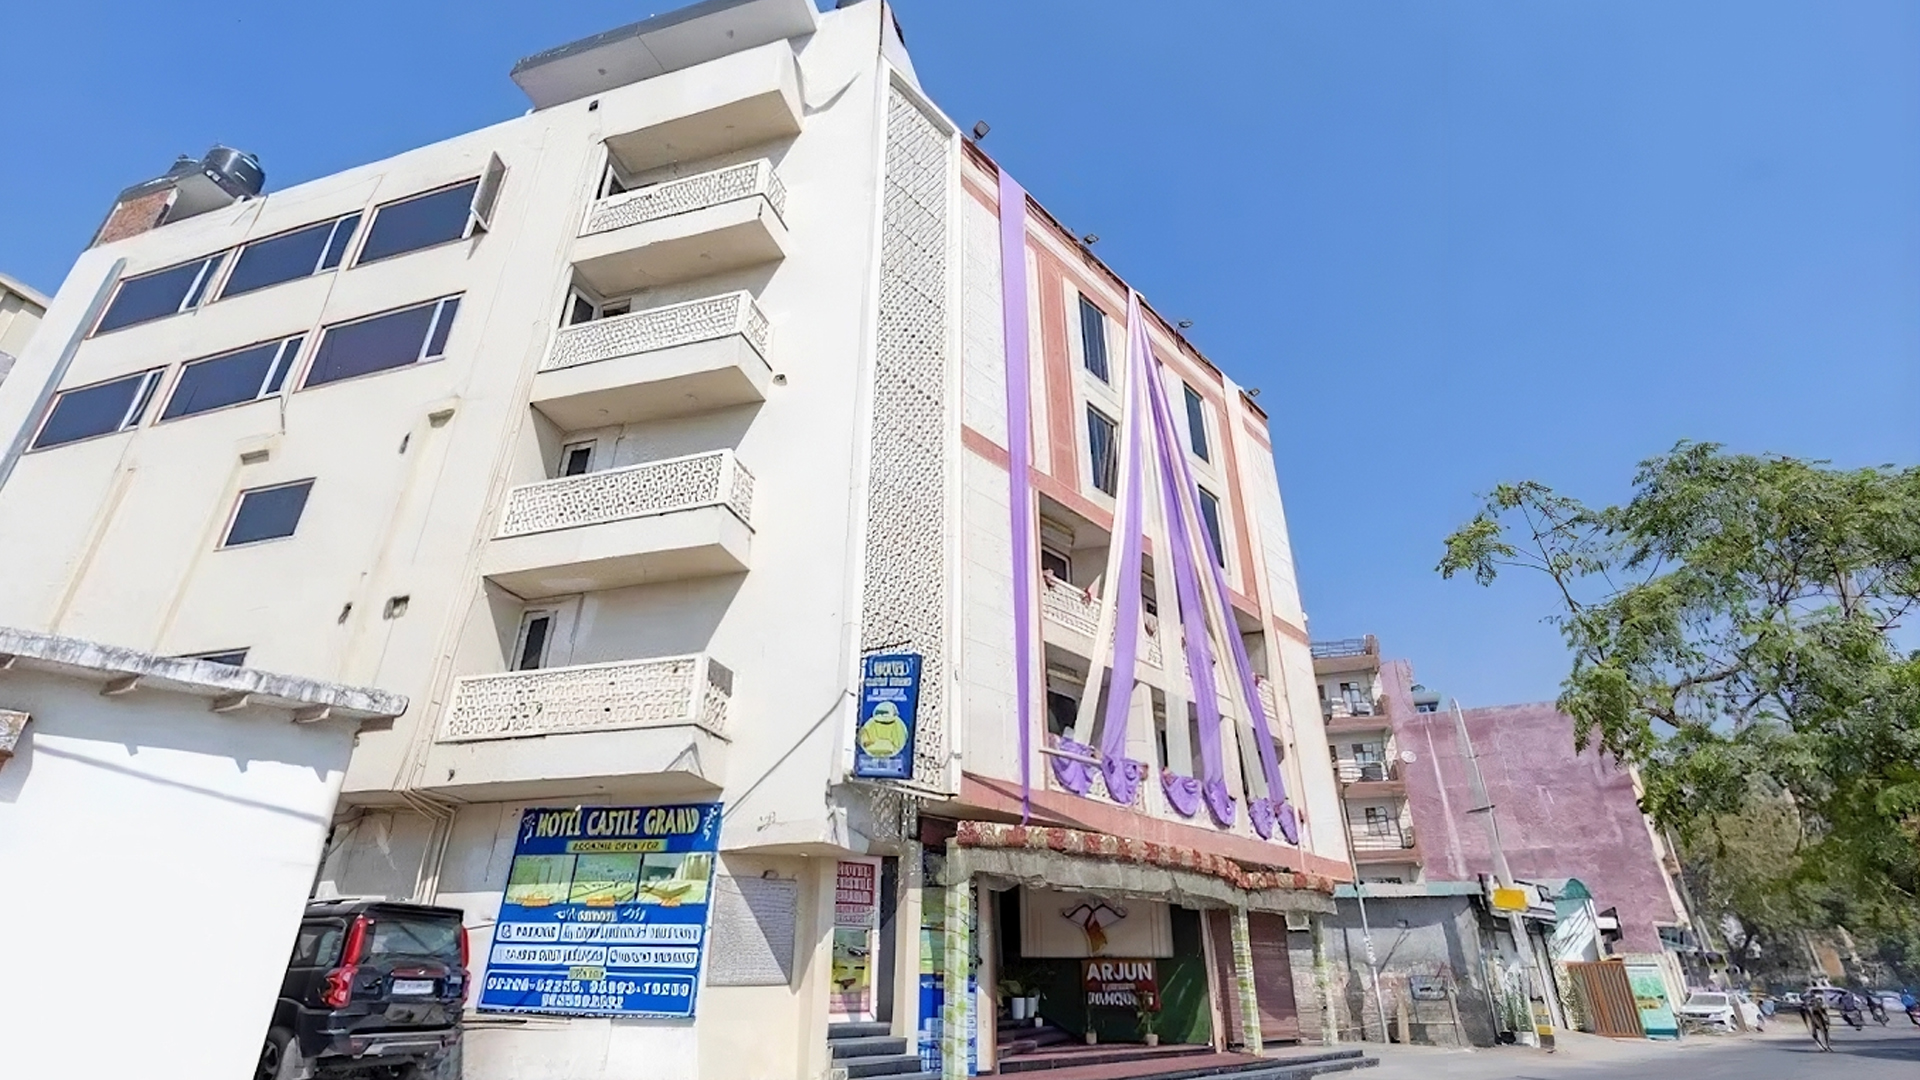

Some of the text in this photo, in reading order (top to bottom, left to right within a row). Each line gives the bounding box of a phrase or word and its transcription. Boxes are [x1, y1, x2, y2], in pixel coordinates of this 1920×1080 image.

[535, 808, 699, 838] HOTEL CASTLE GRAND
[1087, 962, 1152, 981] ARJUN
